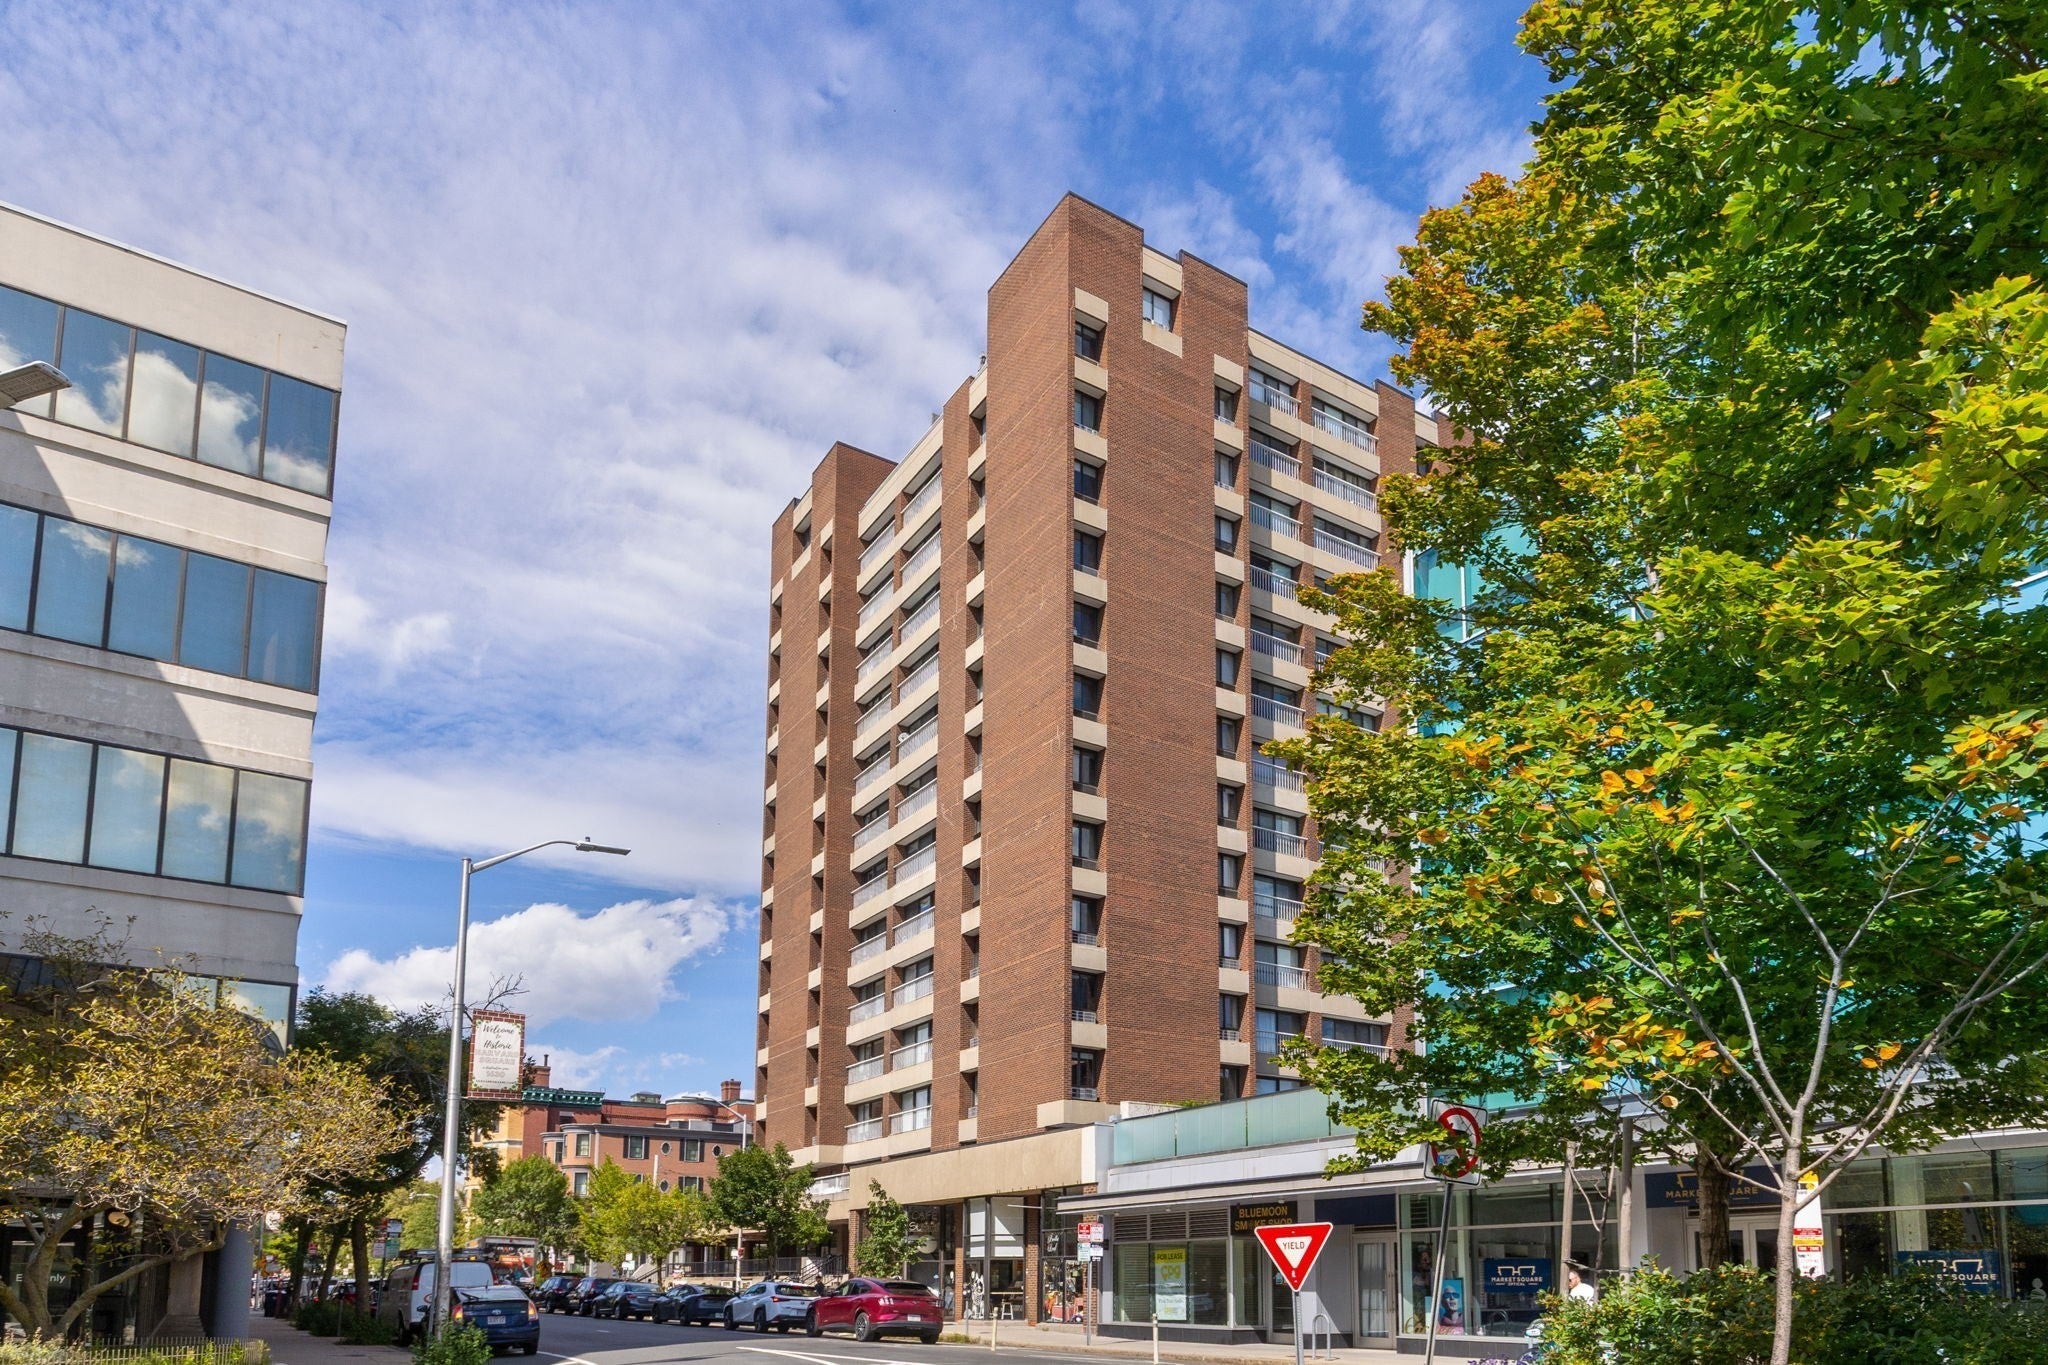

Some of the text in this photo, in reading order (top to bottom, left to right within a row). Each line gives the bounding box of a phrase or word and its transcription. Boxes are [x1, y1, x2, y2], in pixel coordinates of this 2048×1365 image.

[483, 1025, 513, 1033] Welcome
[484, 1040, 512, 1049] Historic
[1665, 1190, 1701, 1199] MARKE
[1238, 1206, 1289, 1219] BLUEMOON
[1234, 1219, 1267, 1231] SMKE
[1282, 1241, 1305, 1250] YIELD
[1168, 1252, 1184, 1260] LEASE
[1951, 1273, 1998, 1281] SQUARE
